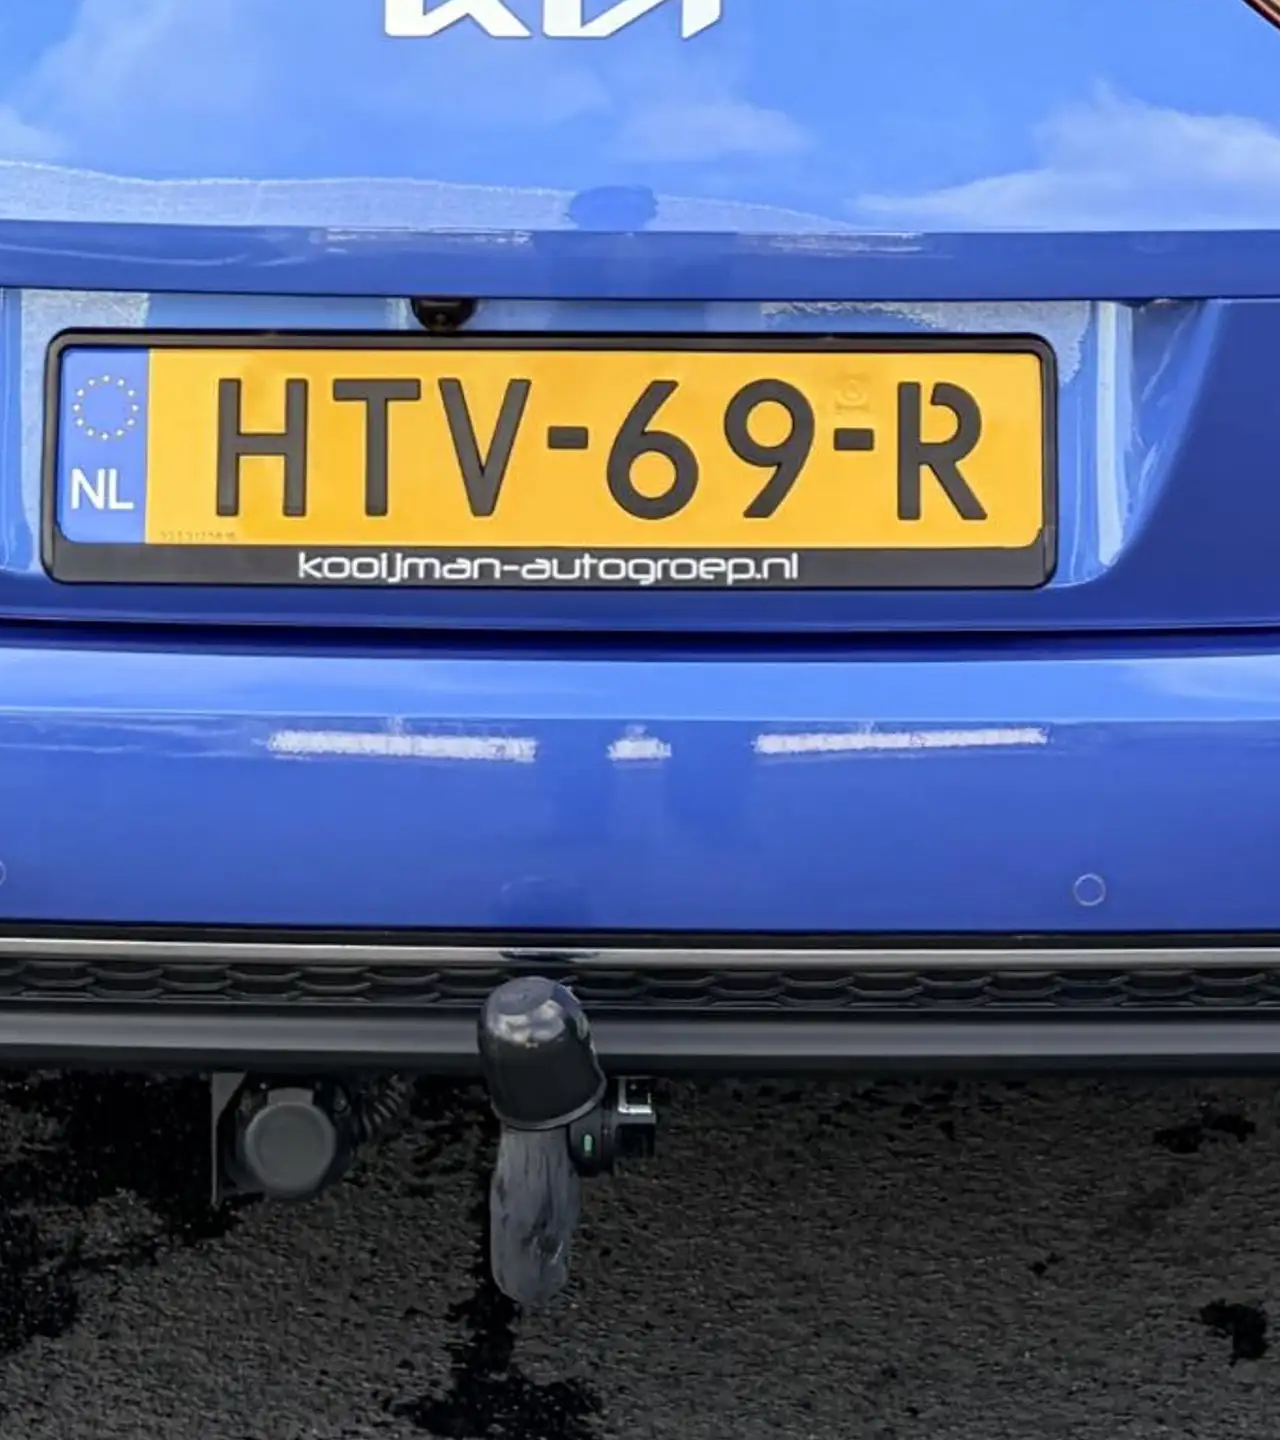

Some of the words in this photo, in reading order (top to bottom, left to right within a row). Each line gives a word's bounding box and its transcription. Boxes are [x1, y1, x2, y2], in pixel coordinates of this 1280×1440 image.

[216, 377, 989, 521] HTV-69-R
[70, 467, 136, 511] NL
[296, 550, 800, 586] kooijman-autogroep.nl
